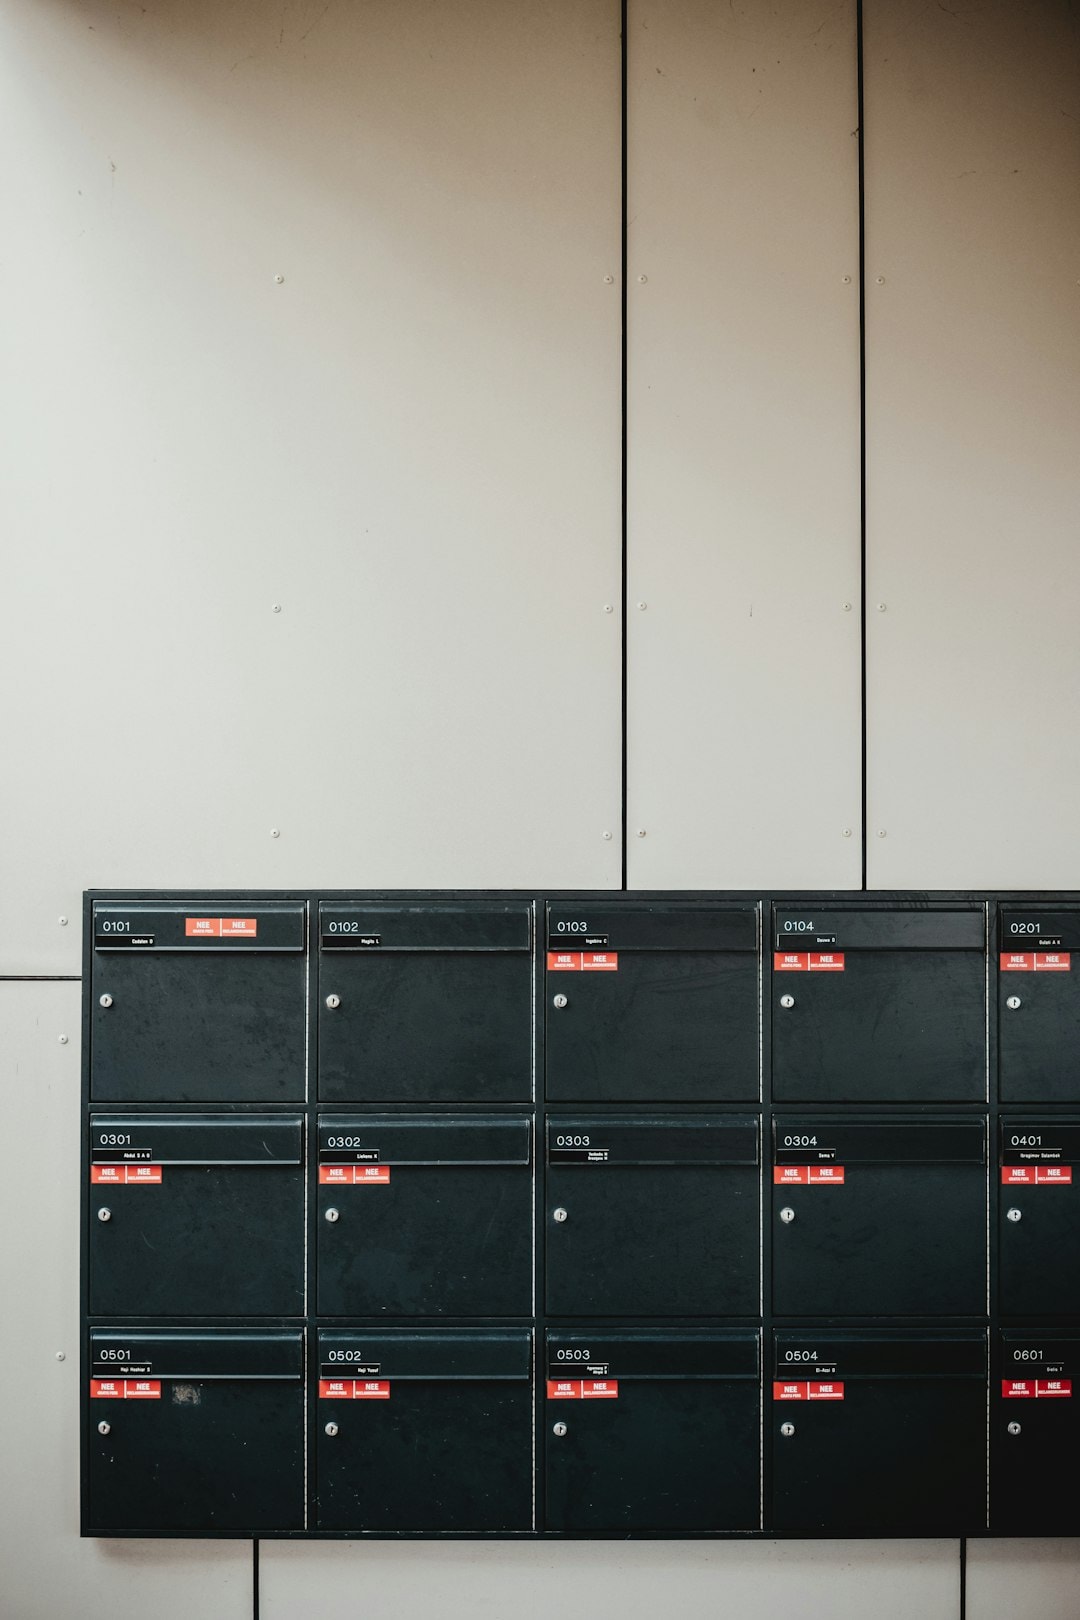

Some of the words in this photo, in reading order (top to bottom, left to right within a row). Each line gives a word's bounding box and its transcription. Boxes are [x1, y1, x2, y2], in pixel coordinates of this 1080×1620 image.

[102, 921, 130, 932] 0101
[196, 921, 210, 929] NEE
[232, 921, 246, 929] NEE
[329, 921, 359, 932] 0102
[557, 921, 588, 932] 0103
[784, 920, 815, 931] 0104
[1010, 922, 1040, 933] 0201
[557, 955, 572, 963] NEE
[593, 955, 607, 963] NEE
[784, 955, 798, 963] NEE
[819, 955, 833, 963] NEE
[1010, 955, 1024, 963] NEE
[1046, 955, 1059, 963] NEE
[100, 1134, 131, 1145] 0301
[328, 1136, 360, 1147] 0302
[556, 1135, 590, 1146] 0303
[784, 1135, 817, 1146] 0304
[1011, 1135, 1042, 1146] 0401
[101, 1168, 116, 1176] NEE
[329, 1168, 344, 1176] NEE
[1047, 1168, 1061, 1176] NEE
[100, 1349, 131, 1360] 0501
[328, 1350, 361, 1361] 0502
[557, 1349, 590, 1360] 0503
[785, 1350, 818, 1361] 0504
[1013, 1350, 1043, 1360] 0601
[557, 1383, 572, 1391] NEE
[784, 1385, 798, 1393] NEE
[1012, 1382, 1026, 1390] NEE
